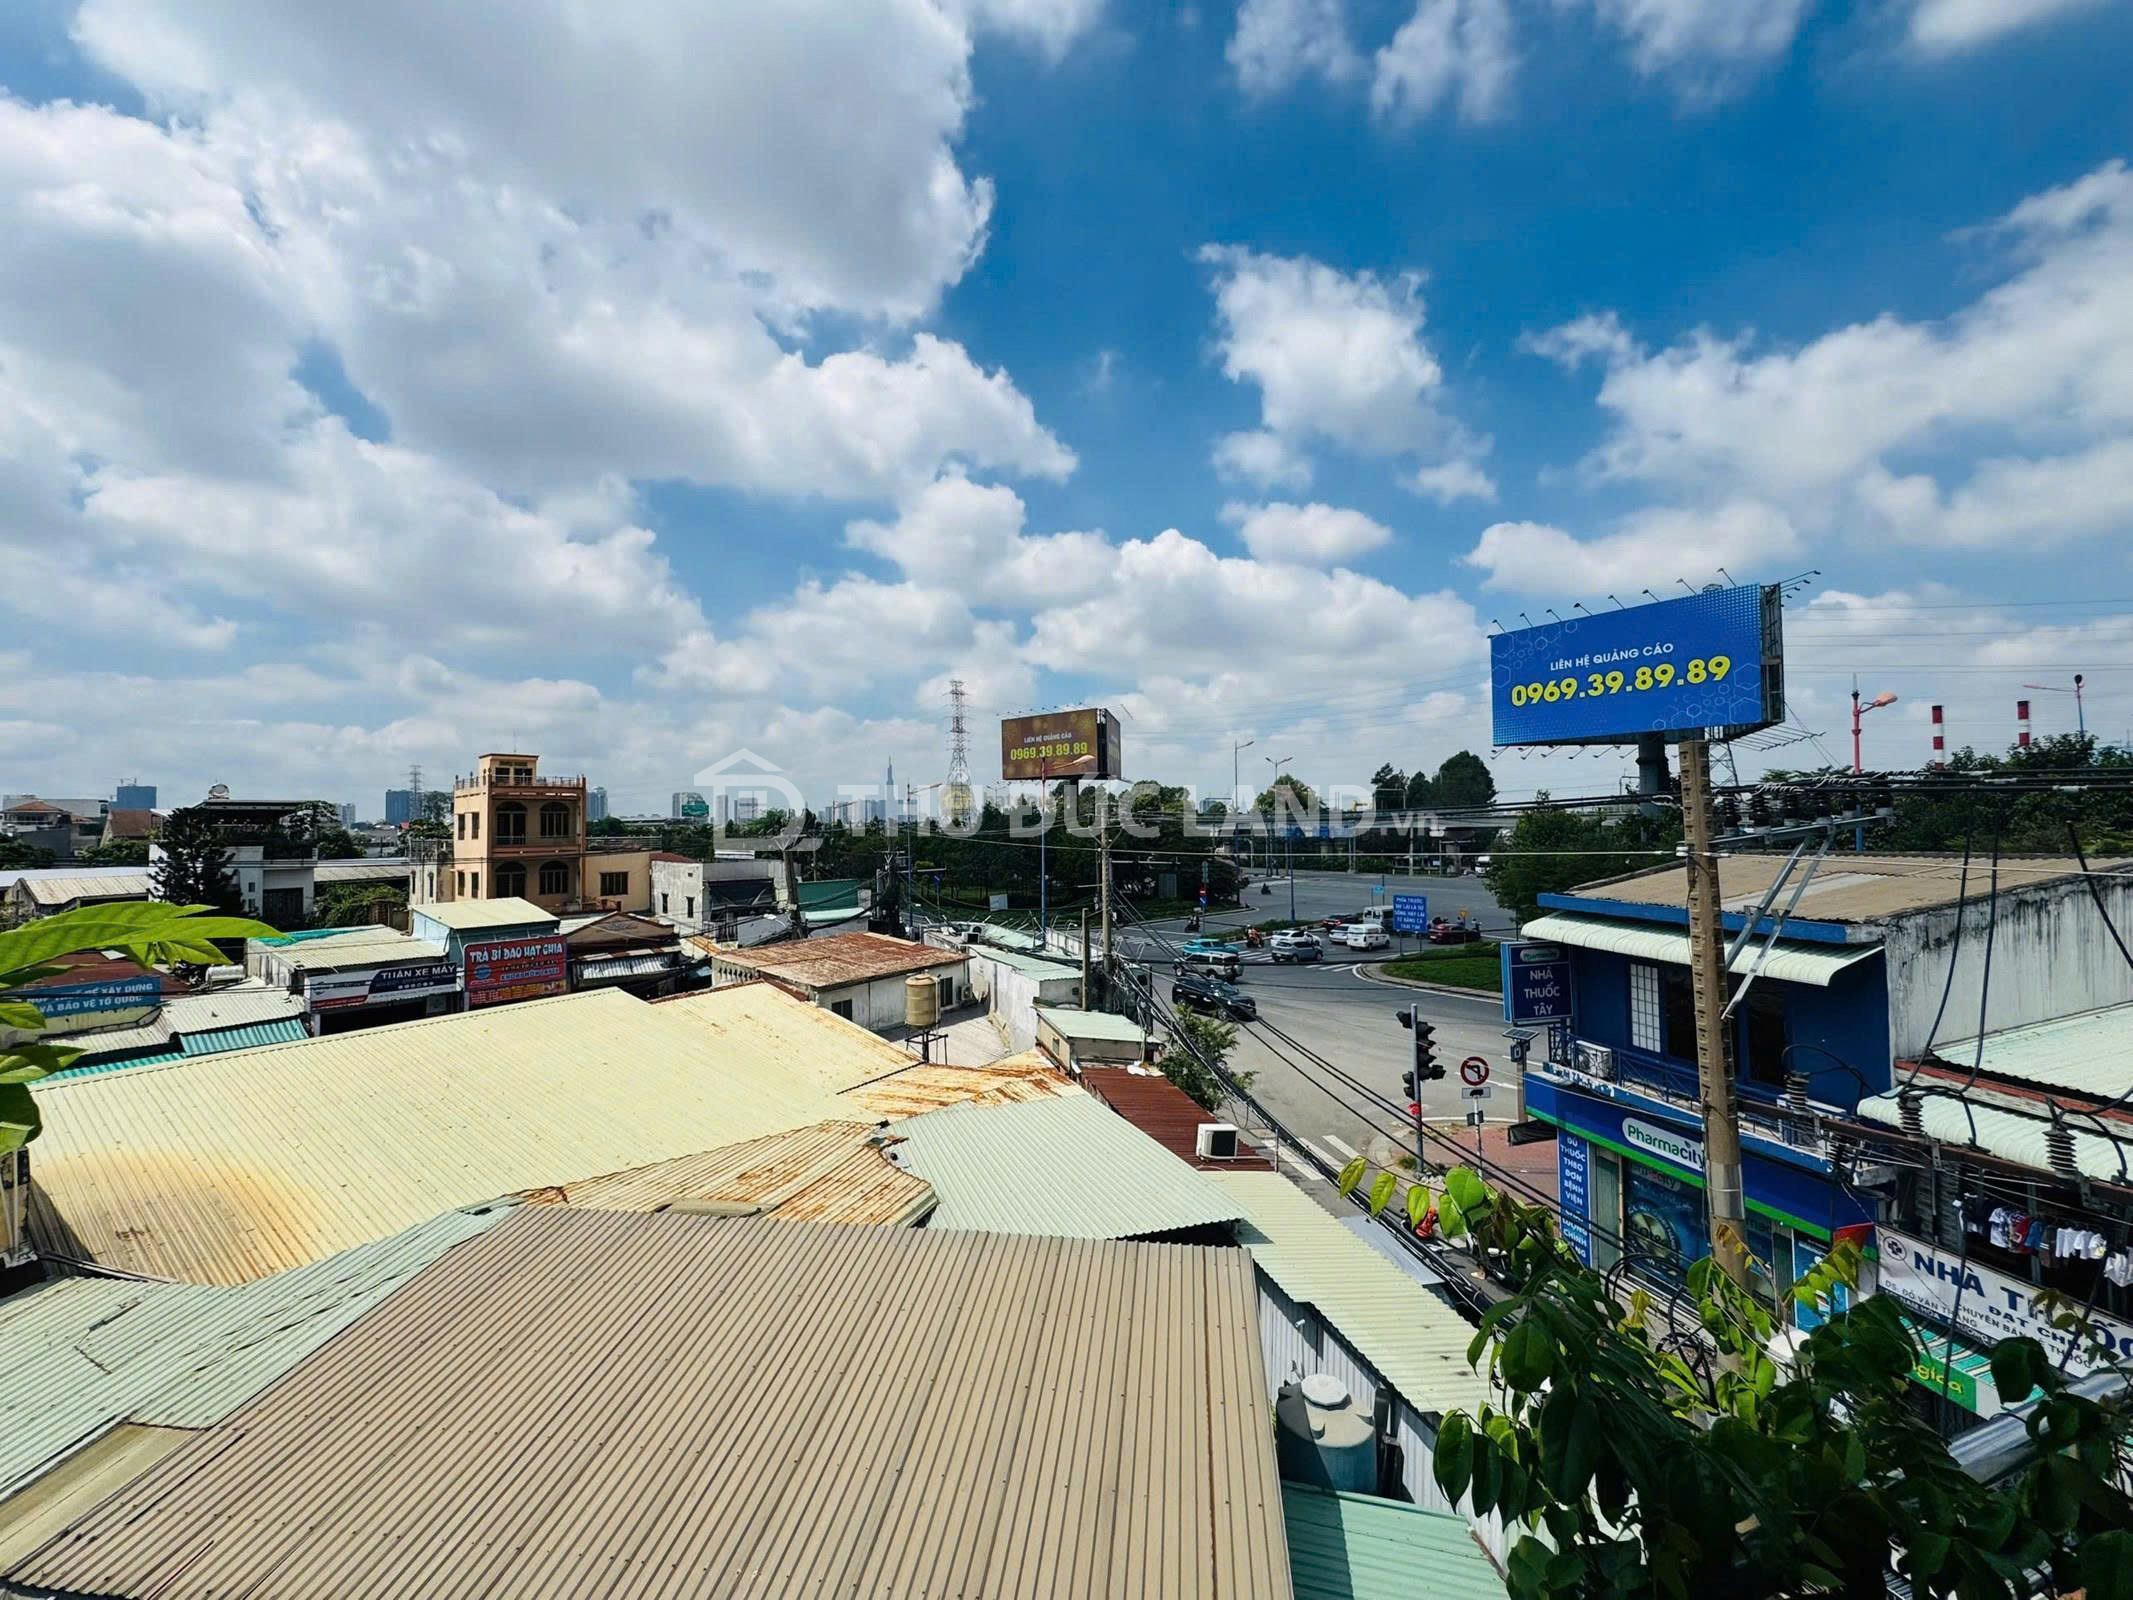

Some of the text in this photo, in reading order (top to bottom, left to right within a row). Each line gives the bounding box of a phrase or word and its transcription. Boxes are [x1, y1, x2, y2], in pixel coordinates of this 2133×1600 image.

[1550, 642, 1674, 671] LIÊN HỆ QUẢNG CÁO
[1511, 655, 1731, 707] 0969.39.89.89
[1010, 742, 1088, 761] 0969.39.89.89
[469, 947, 489, 963] TRÀ
[491, 946, 502, 961] BÍ
[542, 943, 563, 956] CHIA
[415, 967, 429, 977] XE
[1524, 981, 1560, 999] THUỐC
[83, 999, 96, 1009] VỆ
[1533, 1002, 1553, 1016] TÂY
[1560, 1144, 1586, 1162] THUỐC
[1628, 1124, 1705, 1169] Pharmacity
[1563, 1157, 1584, 1172] THEO
[1914, 1250, 1986, 1298] NHÀ
[1988, 1305, 2028, 1328] ĐẠT
